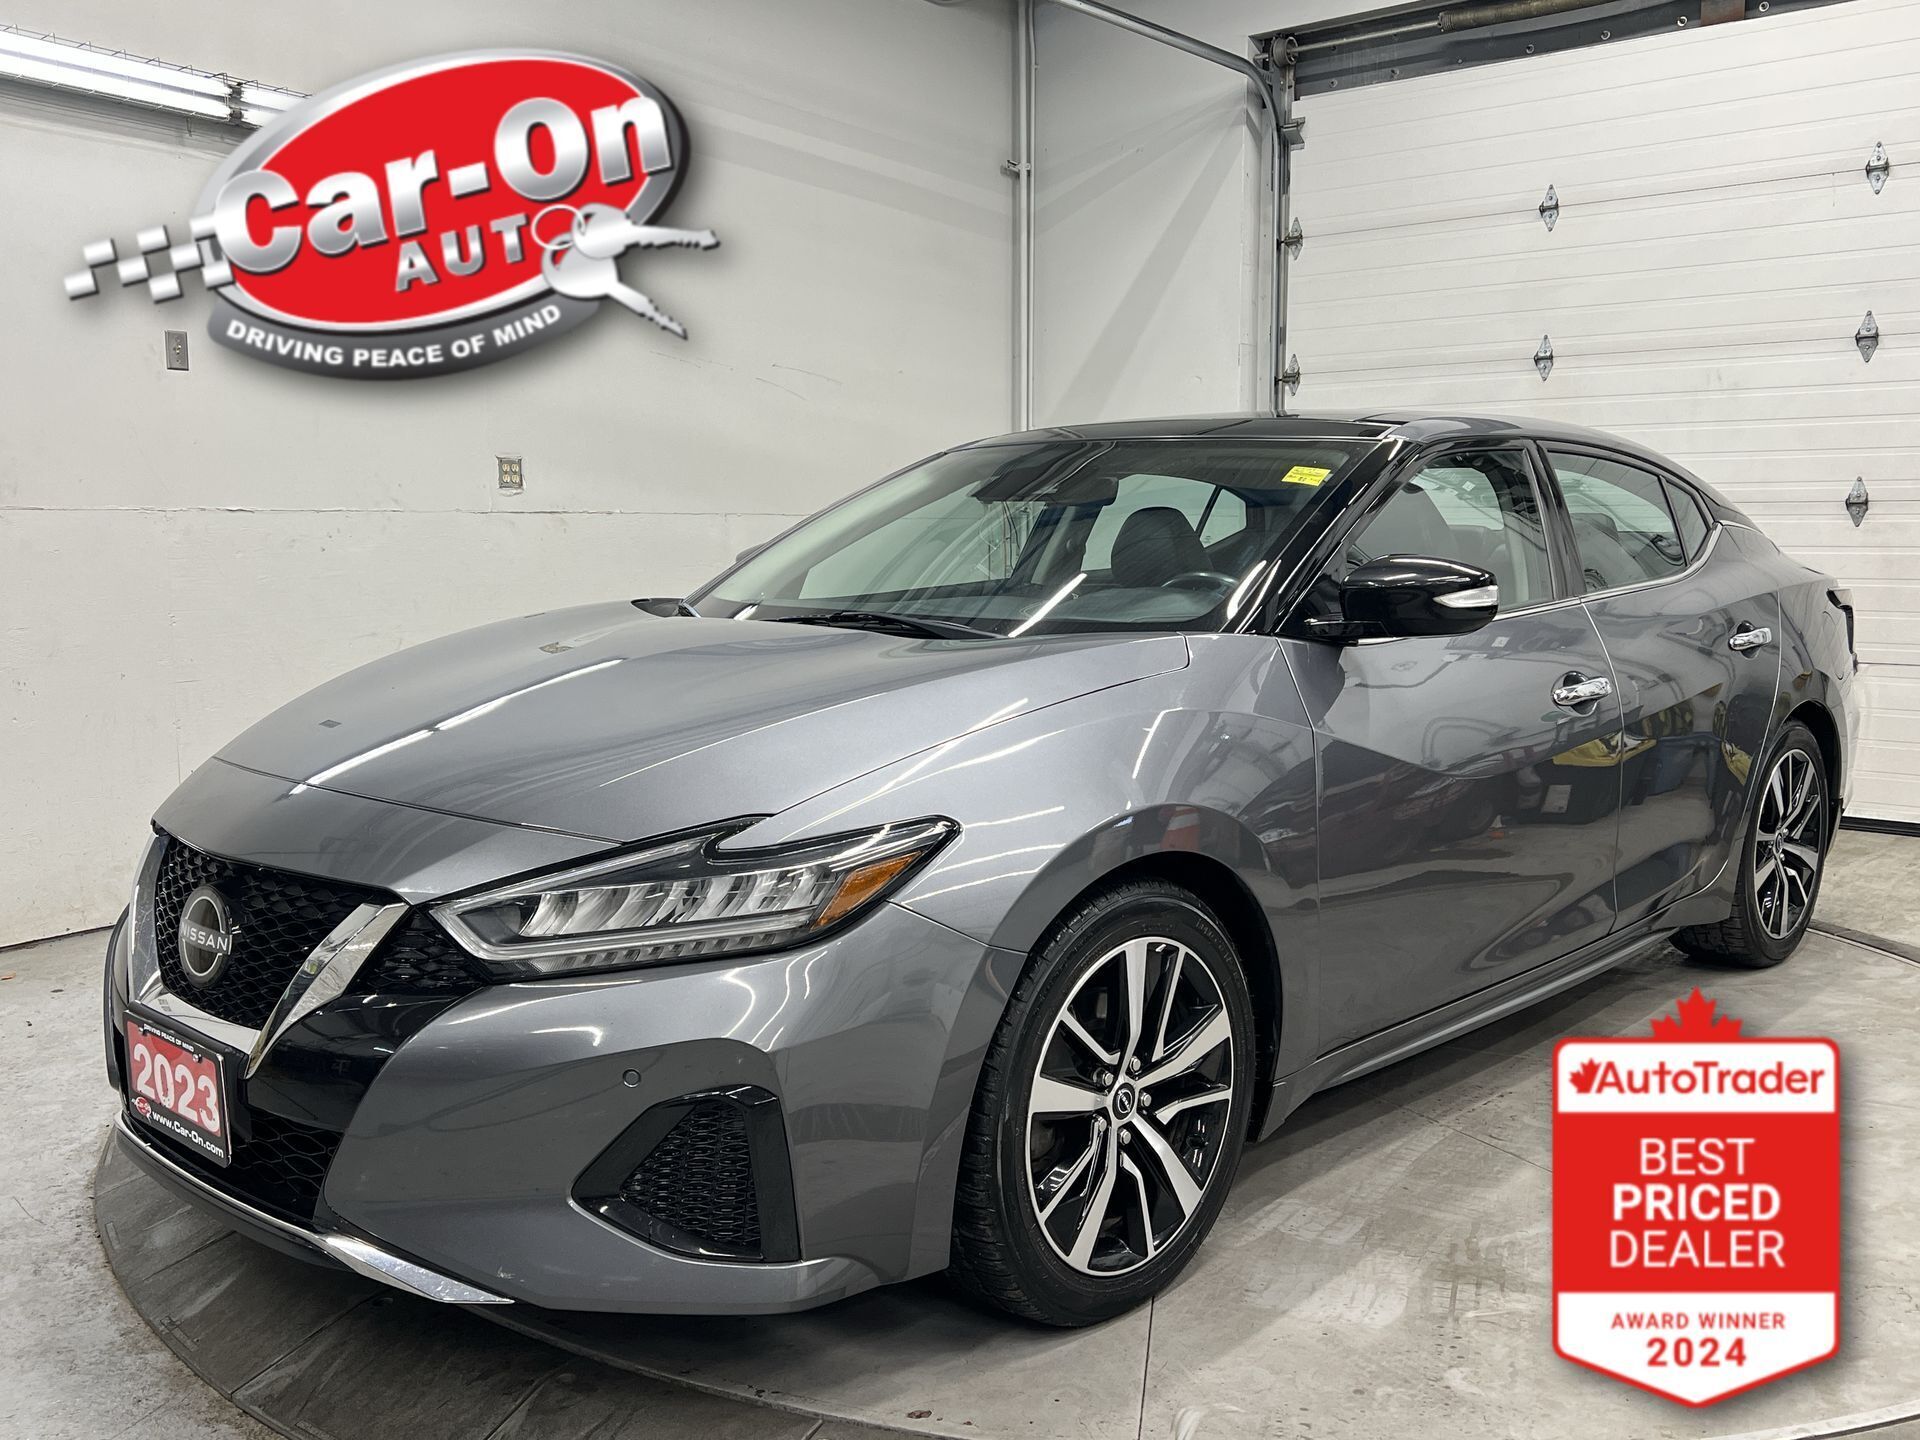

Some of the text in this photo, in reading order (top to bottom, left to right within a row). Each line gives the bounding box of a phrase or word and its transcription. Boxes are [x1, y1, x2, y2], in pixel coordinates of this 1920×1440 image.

[180, 921, 228, 951] NISSAN
[134, 1043, 220, 1132] 2023
[152, 1111, 224, 1159] www.Car-On.com
